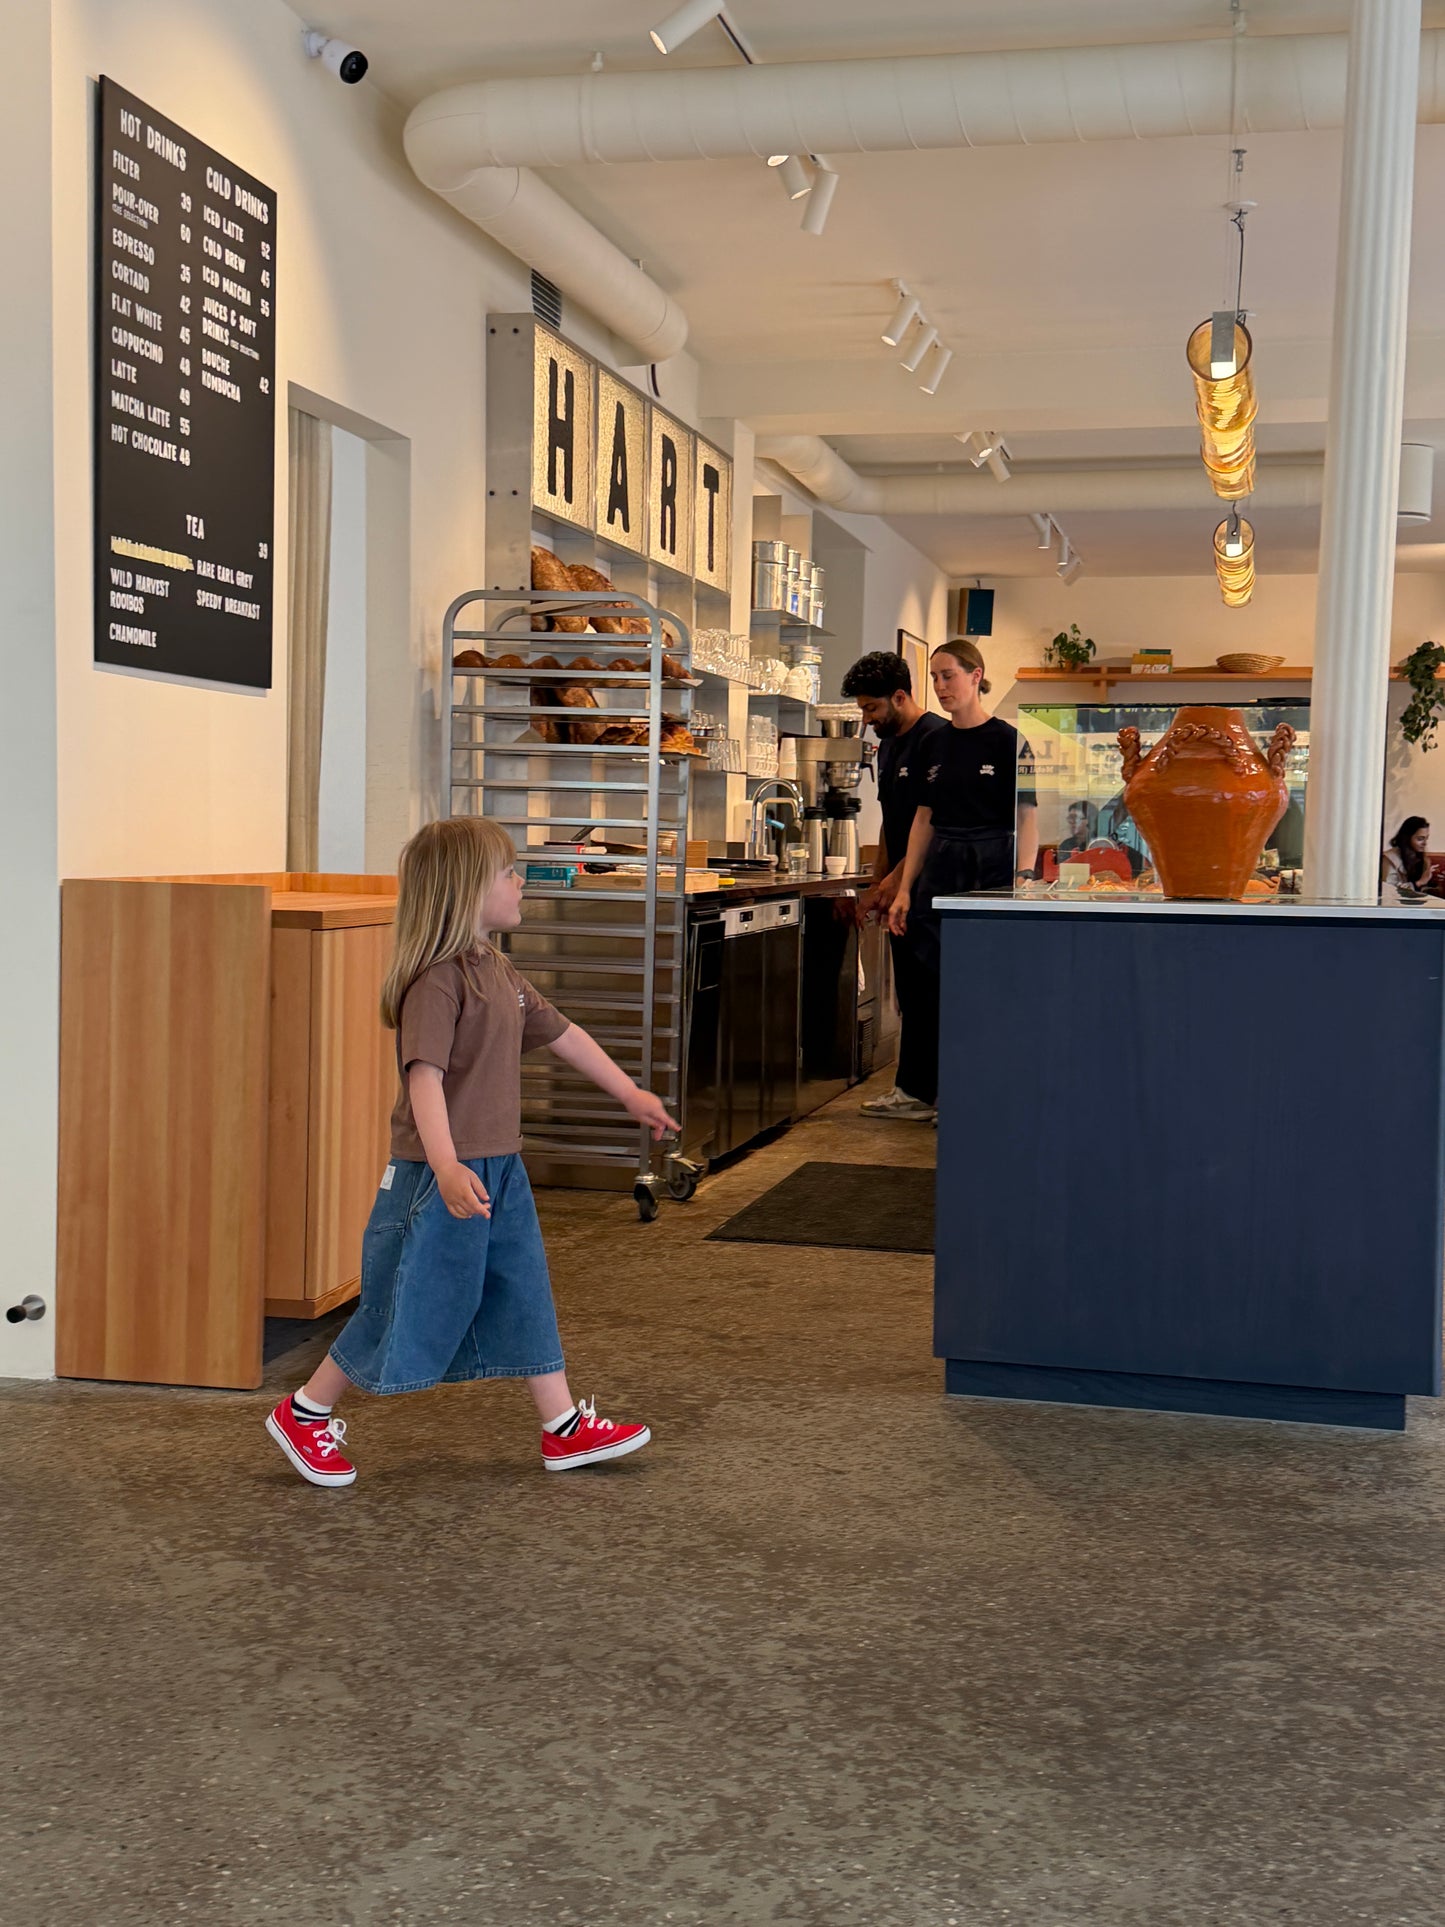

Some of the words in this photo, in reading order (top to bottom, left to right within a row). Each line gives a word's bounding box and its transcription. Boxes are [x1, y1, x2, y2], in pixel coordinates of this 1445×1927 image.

[120, 109, 141, 142] HOT
[147, 125, 186, 171] DRINKS
[113, 150, 140, 181] FILTER
[181, 192, 192, 213] 39
[206, 166, 231, 200] COLD
[235, 185, 269, 225] DRINKS
[112, 183, 159, 224] POUR-OVER
[180, 224, 191, 243] 60
[203, 205, 220, 229] ICED
[222, 217, 244, 243] LATTE
[261, 241, 271, 260] 52
[112, 227, 155, 266] ESPRESSO
[180, 264, 191, 283] 35
[203, 236, 222, 260] COLD
[224, 248, 246, 273] BREW
[260, 269, 270, 288] 45
[112, 260, 150, 294] CORTADO
[180, 295, 191, 314] 42
[202, 265, 220, 288] ICED
[222, 277, 251, 306] MATCHA
[260, 299, 270, 317] 55
[112, 293, 131, 317] FLAT
[135, 303, 162, 332] WHITE
[180, 326, 190, 345] 45
[202, 297, 228, 323] JUICES
[239, 315, 257, 338] SOFT
[202, 317, 229, 346] DRINKS
[112, 326, 163, 365] CAPPUCCINO
[111, 358, 137, 384] LATTE
[202, 370, 241, 403] KOMBUCHA
[259, 376, 269, 394] 42
[111, 390, 145, 420] MATCHA
[147, 405, 171, 428] LATTE
[180, 417, 190, 436] 55
[111, 423, 128, 444] HOT
[132, 430, 177, 461] CHOCOLATE
[547, 357, 720, 573] HART
[186, 514, 205, 540] TEA
[258, 542, 268, 559] 39
[110, 568, 133, 588] WILD
[135, 574, 170, 598] HARVEST
[197, 559, 215, 579] RARE
[217, 565, 234, 584] EARL
[236, 570, 253, 589] GREY
[110, 590, 145, 614] ROOIBOS
[196, 589, 223, 610] SPEEDY
[224, 597, 260, 620] BREAKFAST
[109, 622, 157, 647] CHAMOMILE
